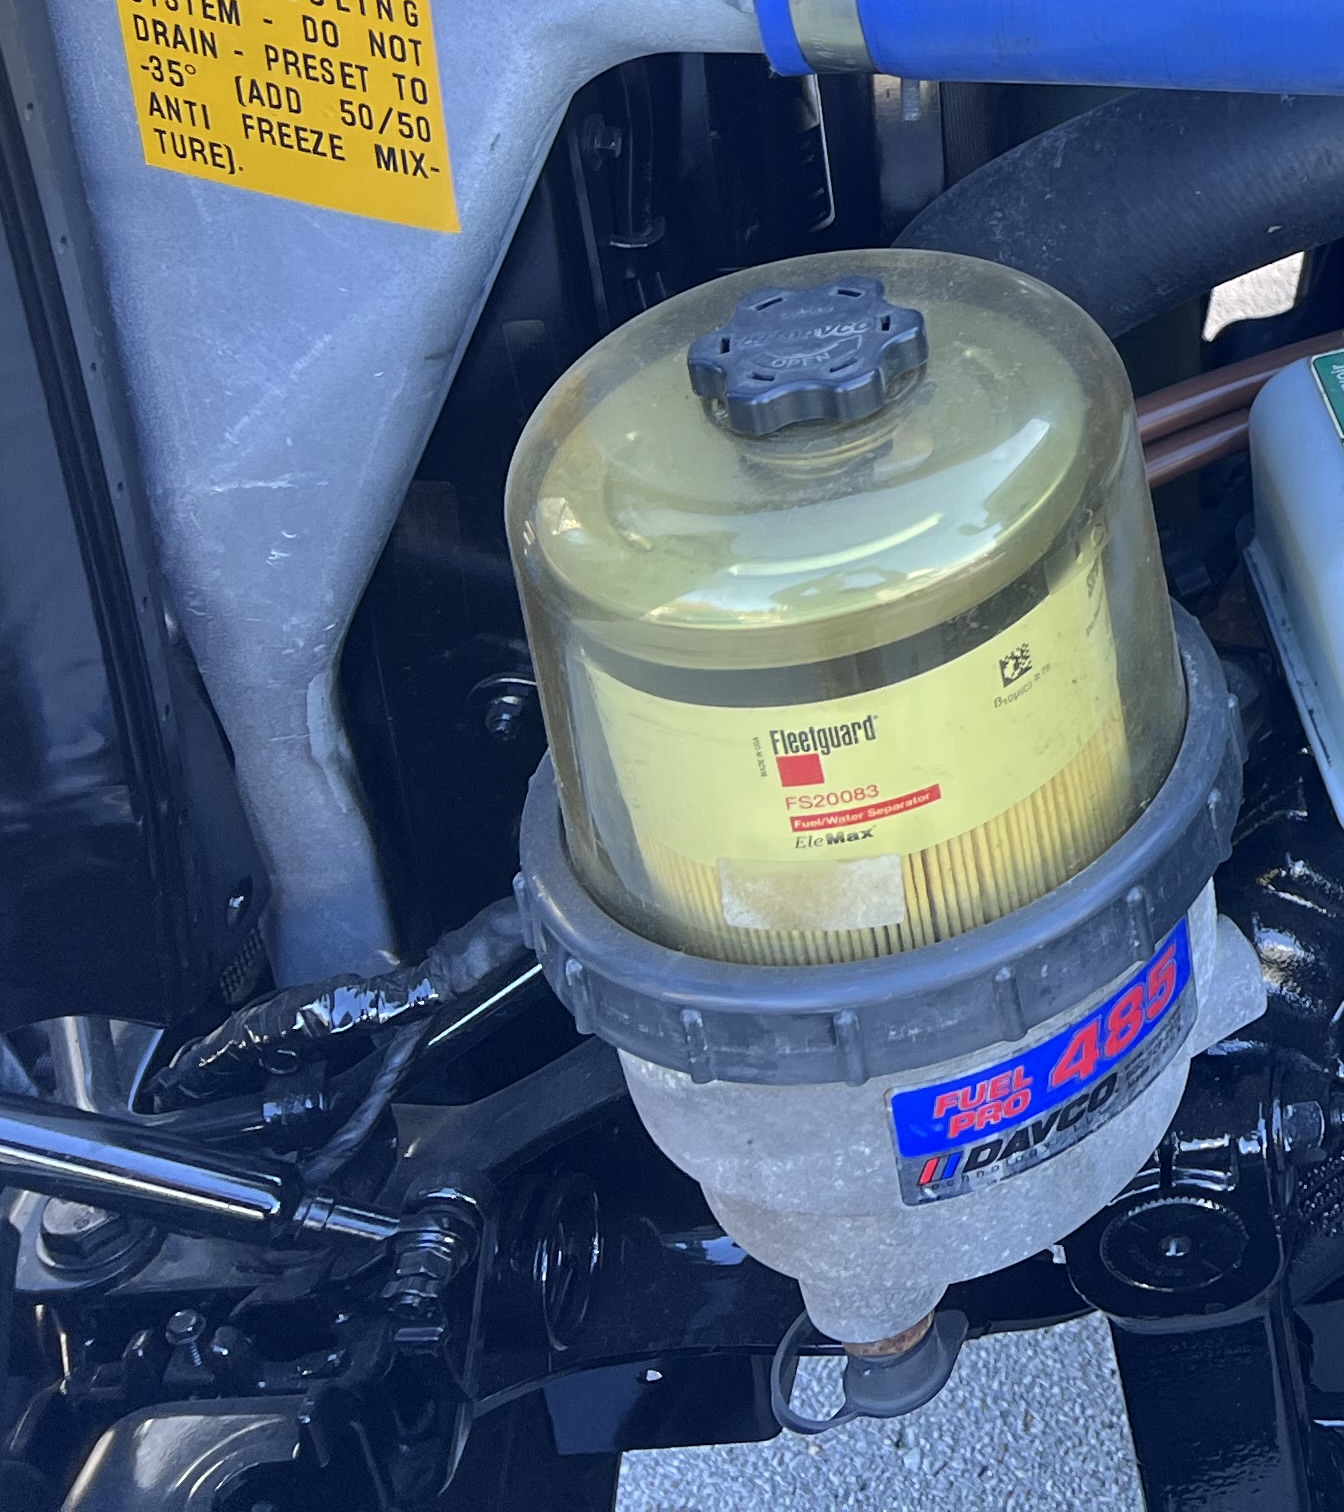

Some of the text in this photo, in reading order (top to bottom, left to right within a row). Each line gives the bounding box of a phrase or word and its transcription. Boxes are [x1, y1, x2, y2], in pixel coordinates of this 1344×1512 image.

[133, 14, 218, 59] DRAIN
[265, 44, 368, 92] PRESET
[392, 72, 428, 105] TO
[302, 14, 339, 48] DO
[368, 29, 422, 66] NOT
[149, 91, 440, 178] ANTI FREEZE MIX-
[235, 75, 301, 115] (ADD
[339, 99, 431, 143] 50/50
[772, 352, 830, 368] OPEN
[769, 714, 877, 755] Fleetguard
[786, 784, 880, 811] FS20083
[794, 792, 931, 829] Fuel/Water Separator
[934, 1065, 1034, 1119] FUEL
[1050, 943, 1178, 1088] 485
[948, 1089, 1032, 1138] PRO
[963, 1072, 1118, 1174] DAVCO
